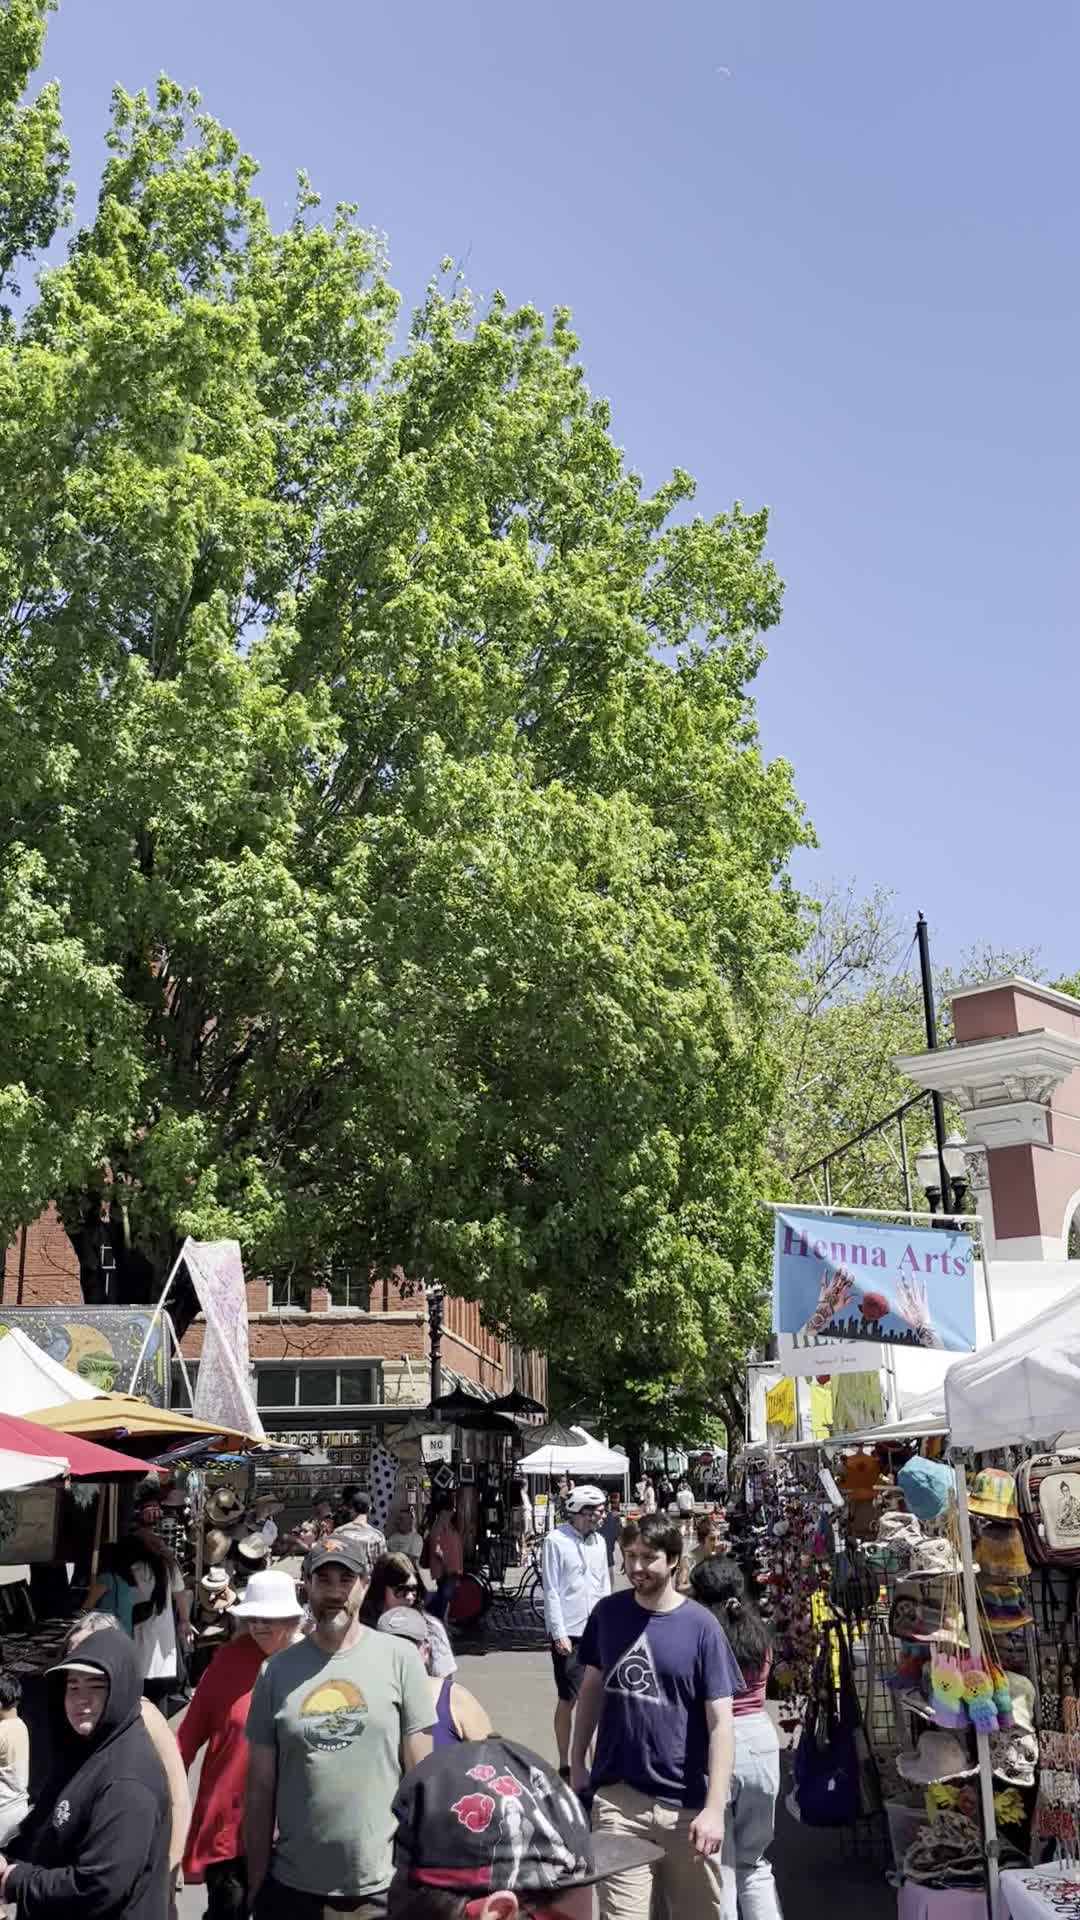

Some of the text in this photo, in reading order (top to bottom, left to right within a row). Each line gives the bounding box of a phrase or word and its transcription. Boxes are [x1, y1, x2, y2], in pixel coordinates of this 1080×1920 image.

[783, 1226, 966, 1277] Henna Arts
[430, 1440, 444, 1449] NO
